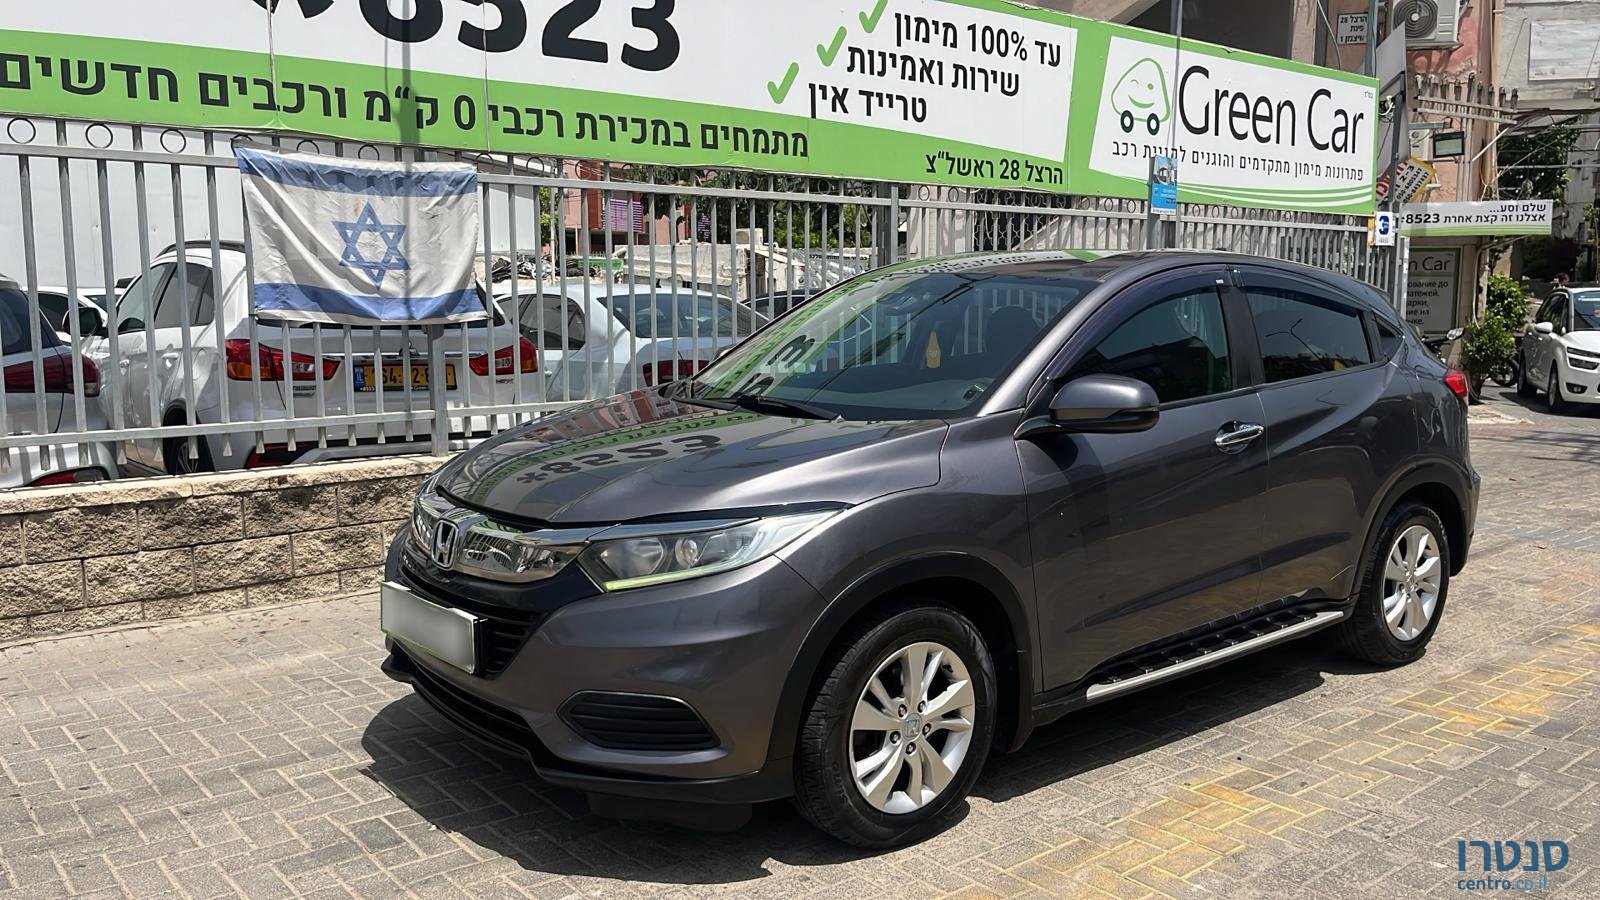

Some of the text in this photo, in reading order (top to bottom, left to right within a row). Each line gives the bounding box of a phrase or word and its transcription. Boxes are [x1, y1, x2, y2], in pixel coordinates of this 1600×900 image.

[895, 13, 1060, 66] עד 100% מימון
[847, 47, 1018, 96] שירות ואמינות
[0, 53, 807, 157] מתמחים במכירת רכבי 0 ק"מ ורכבים חדשים
[809, 83, 926, 122] טרייד אין
[1179, 66, 1363, 153] Green Car
[1113, 142, 1136, 157] רכב
[1192, 151, 1233, 167] והוגנים
[1240, 157, 1289, 175] מתקדמים
[926, 151, 1062, 184] הרצל 28 ראשל"צ
[1295, 163, 1320, 177] מימון
[1325, 166, 1363, 181] פתרונות
[1522, 203, 1546, 212] שלם
[1443, 215, 1472, 223] אחרת
[1475, 214, 1497, 224] קצת
[1501, 214, 1513, 222] זה
[1516, 213, 1546, 222] אצלנו
[1422, 256, 1450, 271] Car
